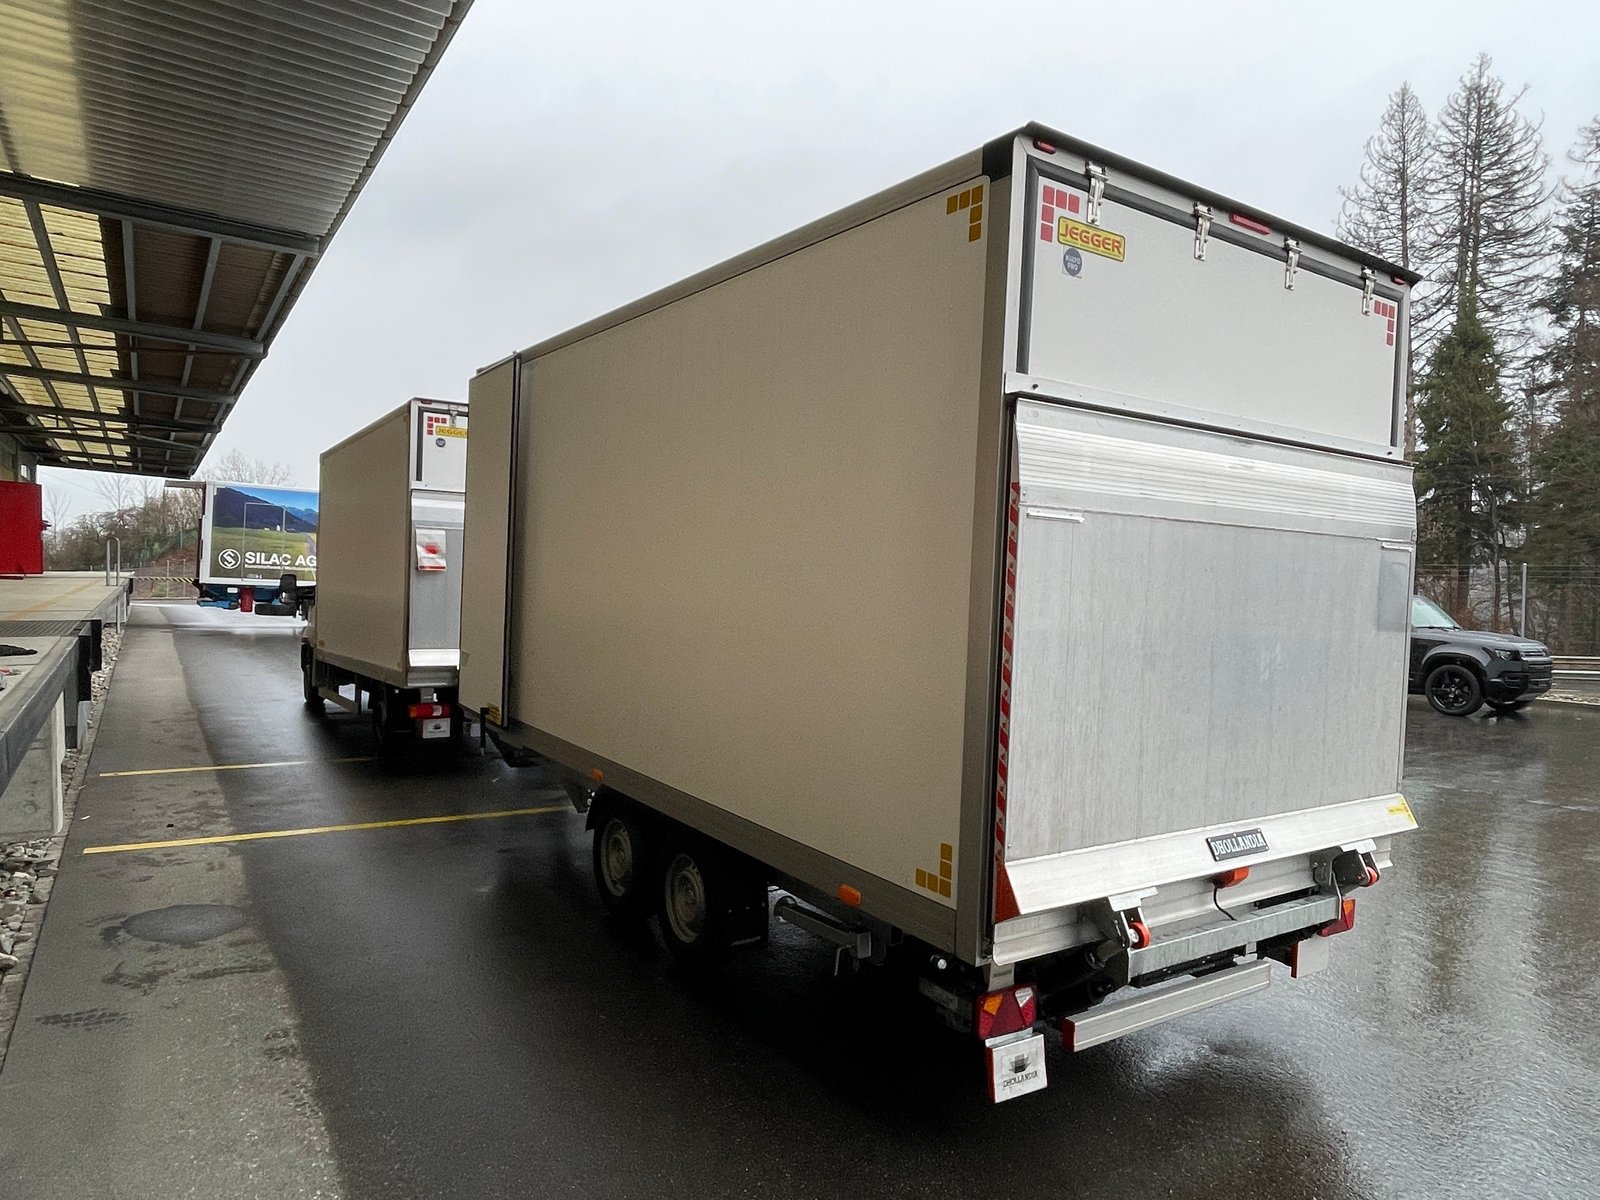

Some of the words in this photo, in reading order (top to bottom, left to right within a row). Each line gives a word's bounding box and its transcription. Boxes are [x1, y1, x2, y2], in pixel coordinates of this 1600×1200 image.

[1059, 223, 1122, 255] JEGGER
[245, 551, 292, 566] SILAC
[295, 555, 317, 567] AG
[1210, 833, 1266, 856] DHOLLANDIA
